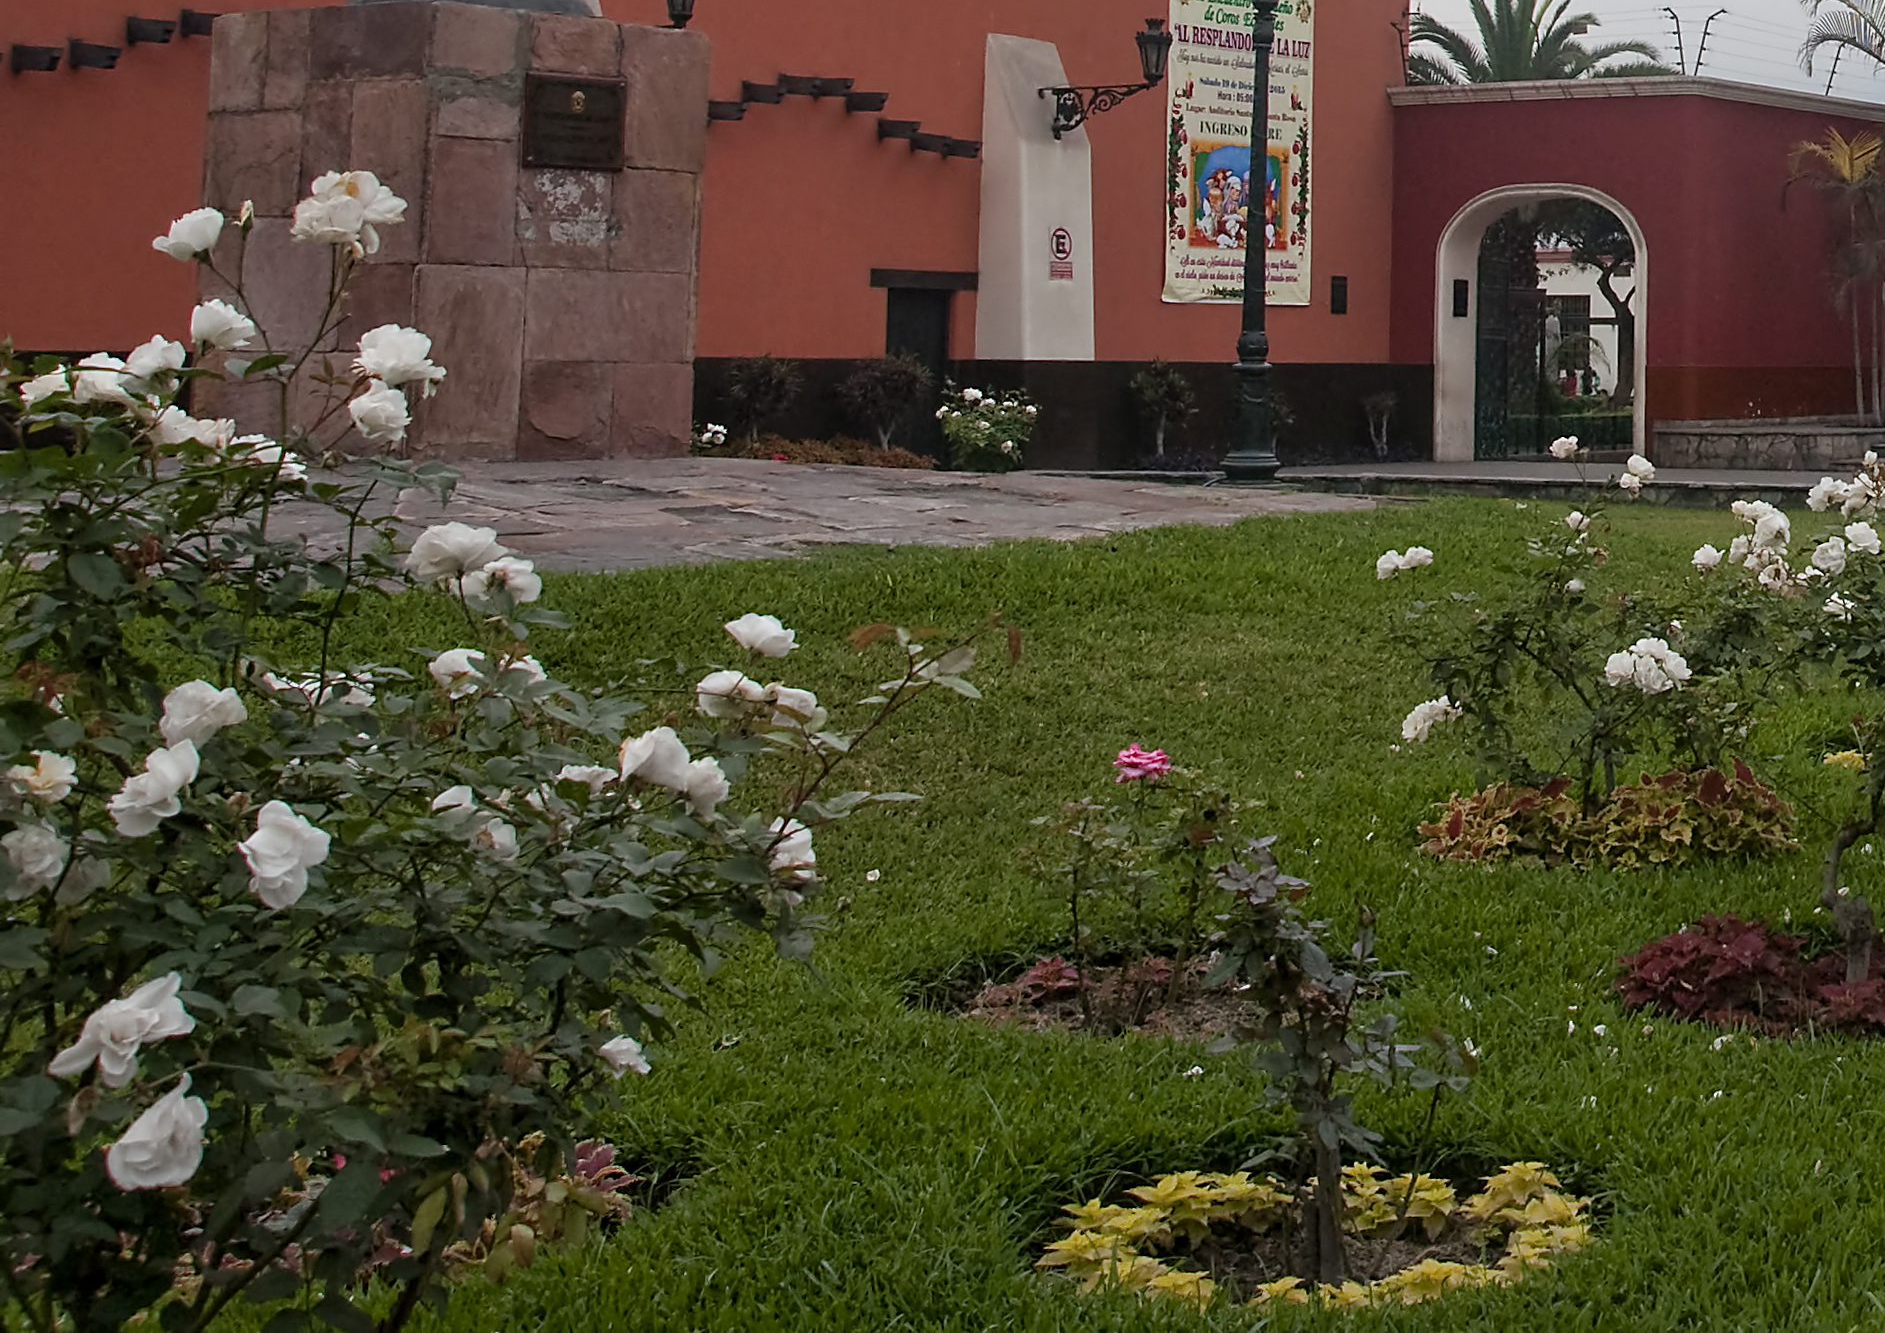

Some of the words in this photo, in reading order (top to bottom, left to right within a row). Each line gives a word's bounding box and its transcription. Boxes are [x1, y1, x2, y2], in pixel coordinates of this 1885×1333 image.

[1204, 4, 1214, 21] de
[1216, 8, 1240, 26] Coros
[1192, 25, 1255, 52] RESPLANDO
[1277, 37, 1290, 57] LA
[1292, 39, 1311, 59] LUZ
[1217, 90, 1231, 101] Hora
[1200, 120, 1248, 137] INGRESO
